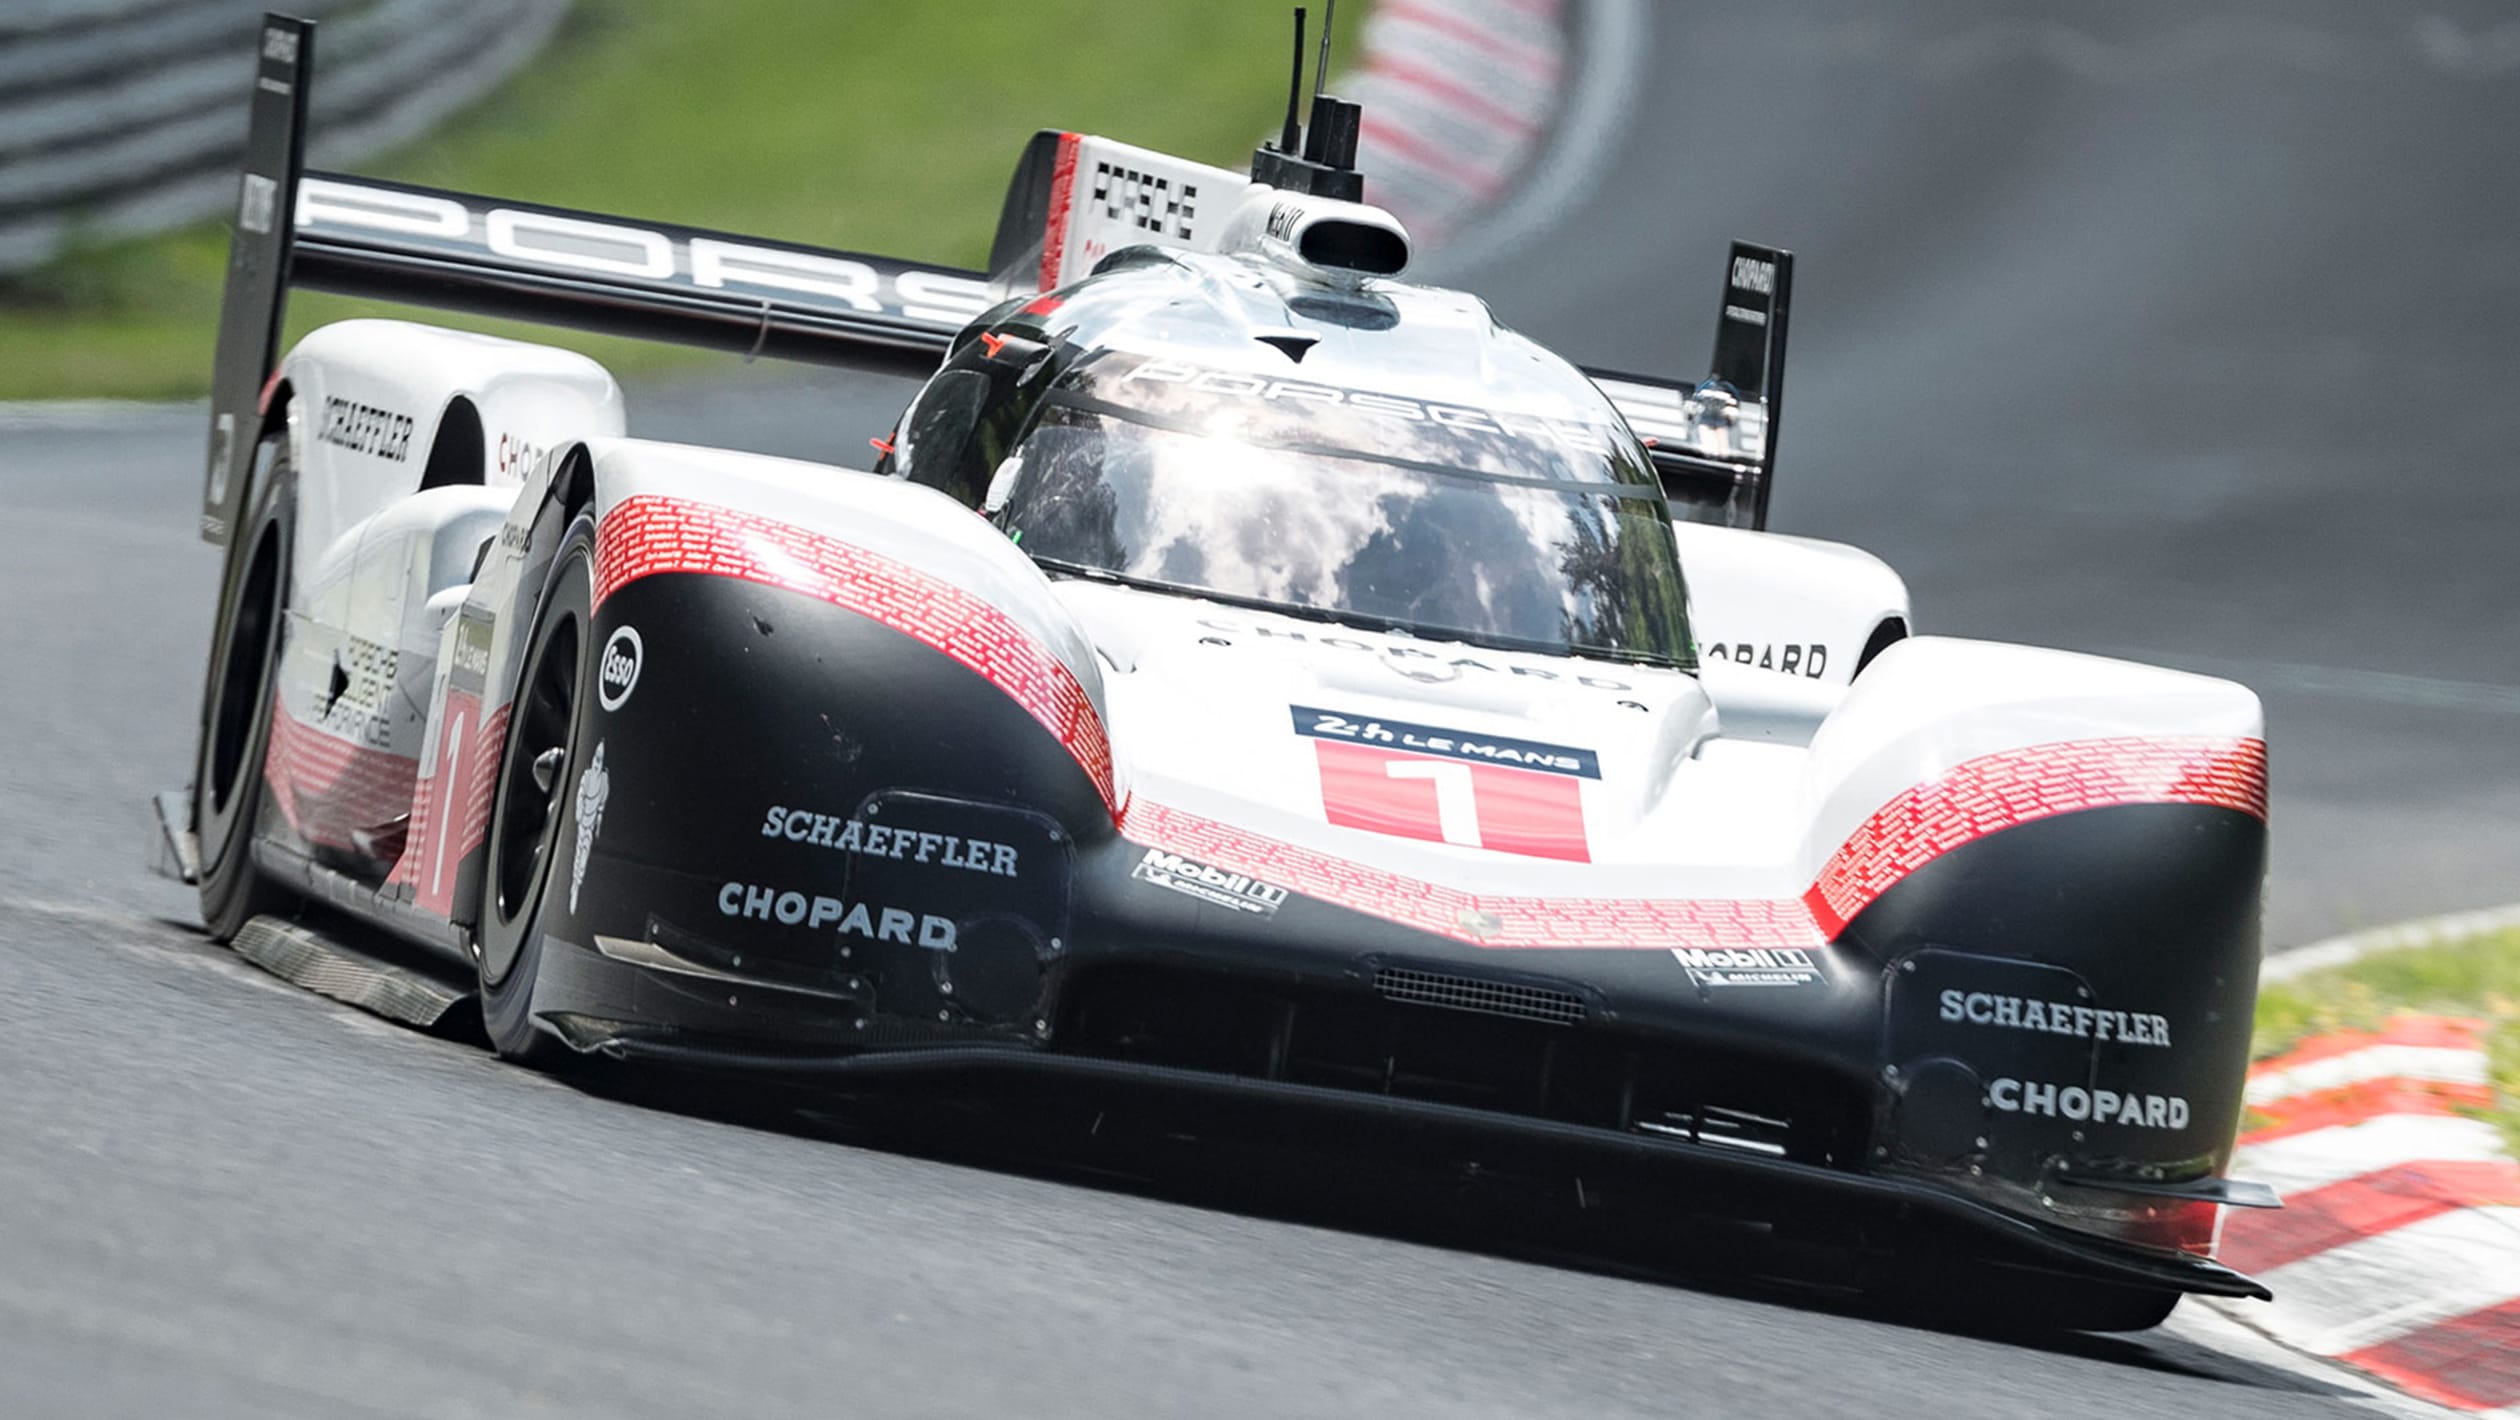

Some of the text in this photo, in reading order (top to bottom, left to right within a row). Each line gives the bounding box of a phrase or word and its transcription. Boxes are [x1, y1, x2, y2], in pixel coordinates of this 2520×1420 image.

[1089, 161, 1198, 240] PORSCHE
[1121, 360, 1608, 454] PORSCHE
[604, 645, 634, 686] Esso
[1197, 619, 1632, 692] CHOPARD
[1402, 734, 1455, 751] LE
[1460, 742, 1581, 771] MANS
[1385, 760, 1483, 848] 1
[762, 805, 1019, 877] SCHAEFFLER
[1142, 848, 1250, 894] Mobil
[717, 882, 957, 950] CHOPARD
[1671, 948, 1778, 968] Mobil
[1939, 989, 2172, 1047] SCHAEFFLER
[1989, 1077, 2190, 1130] CHOPARD
